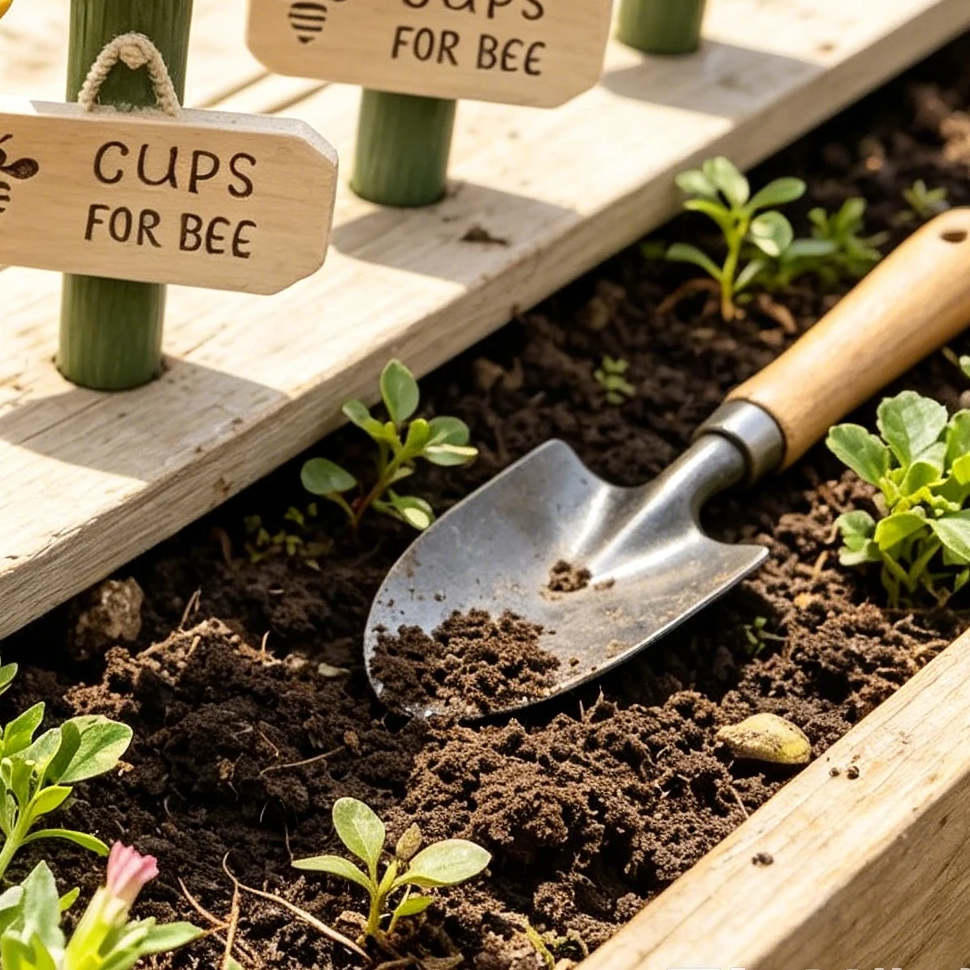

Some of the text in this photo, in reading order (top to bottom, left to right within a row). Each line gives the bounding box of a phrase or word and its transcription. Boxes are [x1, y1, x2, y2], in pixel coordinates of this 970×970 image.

[391, 25, 547, 76] FOR BEE
[93, 140, 258, 198] CUPS
[84, 203, 258, 260] FOR BEE
